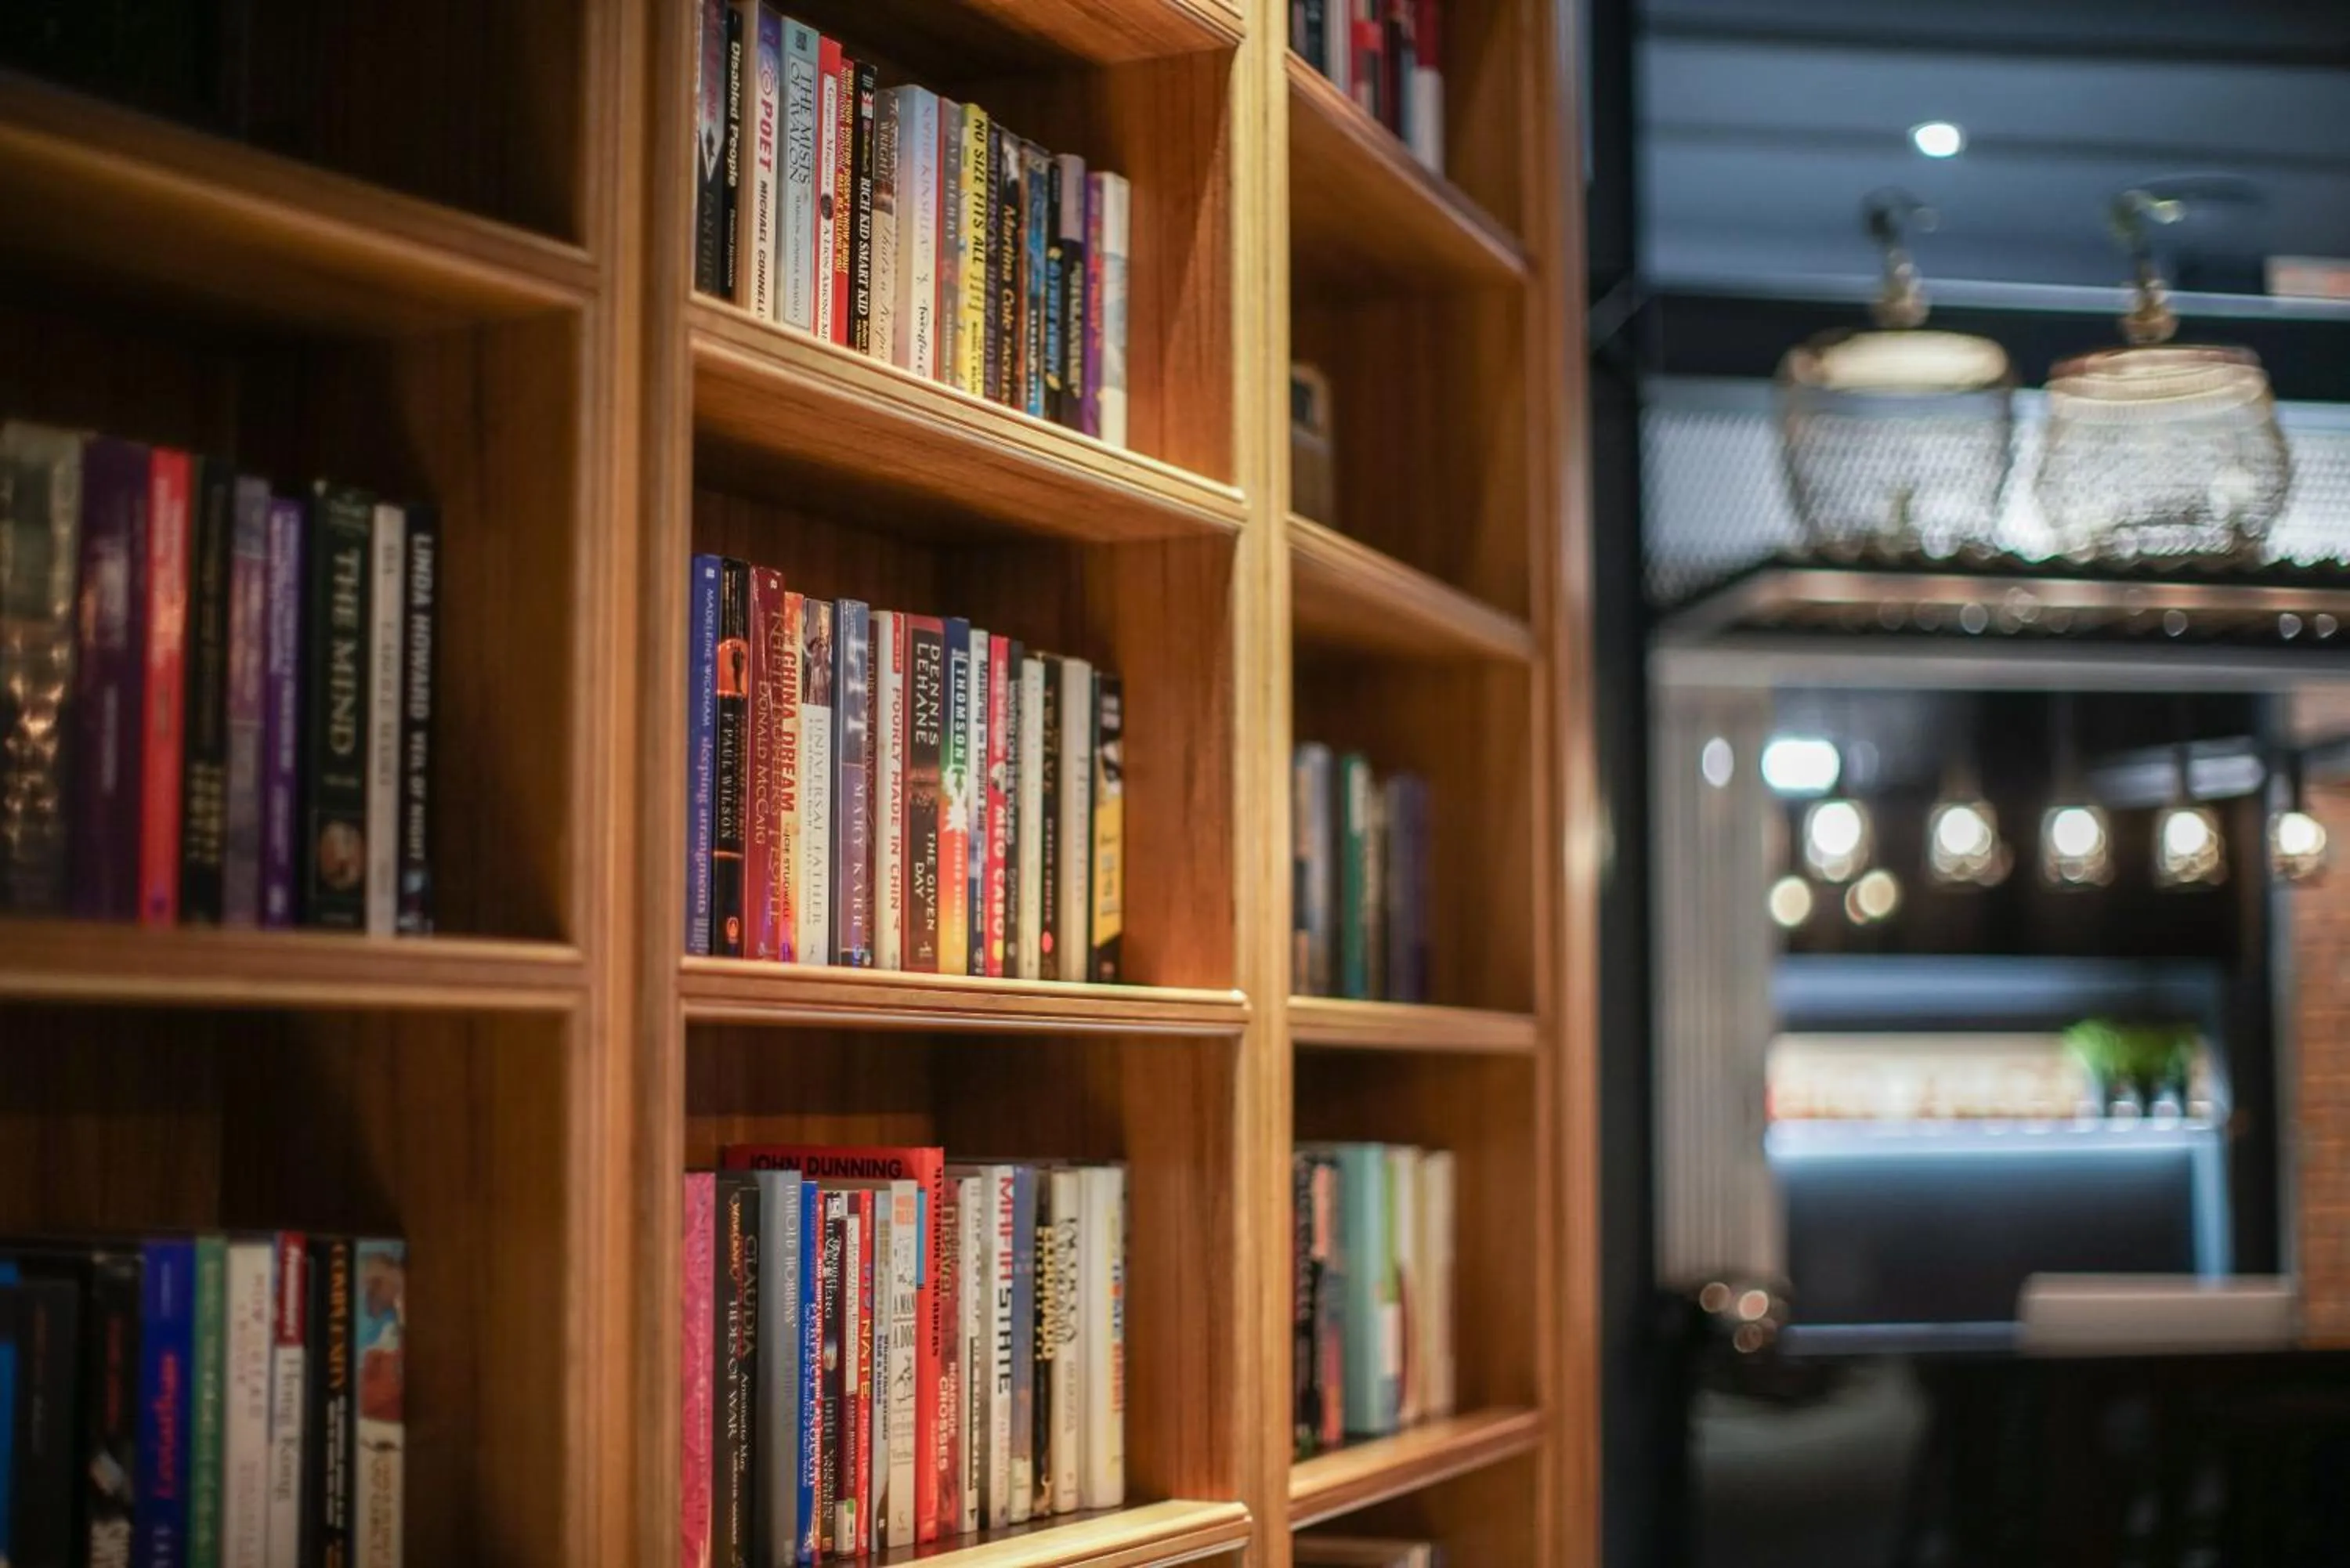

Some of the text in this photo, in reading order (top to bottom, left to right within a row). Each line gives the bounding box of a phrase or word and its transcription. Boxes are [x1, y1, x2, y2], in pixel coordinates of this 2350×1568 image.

[728, 42, 742, 187] Disabled People
[760, 99, 774, 173] POET
[790, 62, 800, 184] OF AVALON
[798, 75, 812, 186] THE MISTS
[758, 180, 768, 243] MICHAEL
[859, 212, 871, 239] KID
[860, 177, 872, 210] RICH
[972, 118, 985, 265] NO SIZE FITS ALL
[834, 253, 843, 273] YOU
[859, 241, 870, 285] SMART
[1002, 204, 1016, 281] Martina
[858, 288, 869, 315] KID
[1002, 288, 1015, 330] Cole
[329, 547, 360, 757] THE MIND
[702, 588, 714, 727] MADELEINE WICKHAM
[848, 637, 869, 742] LIT
[976, 660, 988, 724] Mastering
[408, 533, 434, 862] LINDA HOWARD VEIL OF NIGHT
[757, 681, 769, 760] DONALD
[781, 651, 797, 812] CHINA DREAM
[891, 687, 902, 763] POORLY
[915, 641, 930, 745] LEHANE
[928, 643, 941, 746] DENNIS
[954, 667, 967, 760] THOMSON
[696, 736, 713, 804] sleeping
[721, 728, 734, 769] PAUL
[720, 774, 733, 839] WILSON
[812, 717, 824, 926] UNIVERSAL FATHER
[891, 770, 902, 828] MADE
[783, 833, 791, 854] JOE
[852, 782, 864, 927] MARY KARR
[891, 835, 901, 855] IN
[914, 862, 924, 898] DAY
[927, 832, 938, 932] THE GIVEN
[992, 805, 1006, 937] MEG CABO
[750, 1154, 903, 1179] JOHN DUNNING
[785, 1184, 797, 1249] HAROLD
[941, 1207, 956, 1302] Deaver
[743, 1234, 757, 1358] CLAUDIA
[998, 1176, 1015, 1395] MAFIA STATE
[861, 1319, 871, 1400] NATE
[727, 1390, 738, 1440] WAR
[739, 1371, 750, 1472] Antoinette May
[938, 1361, 957, 1472] ROADSIDE CROSSES
